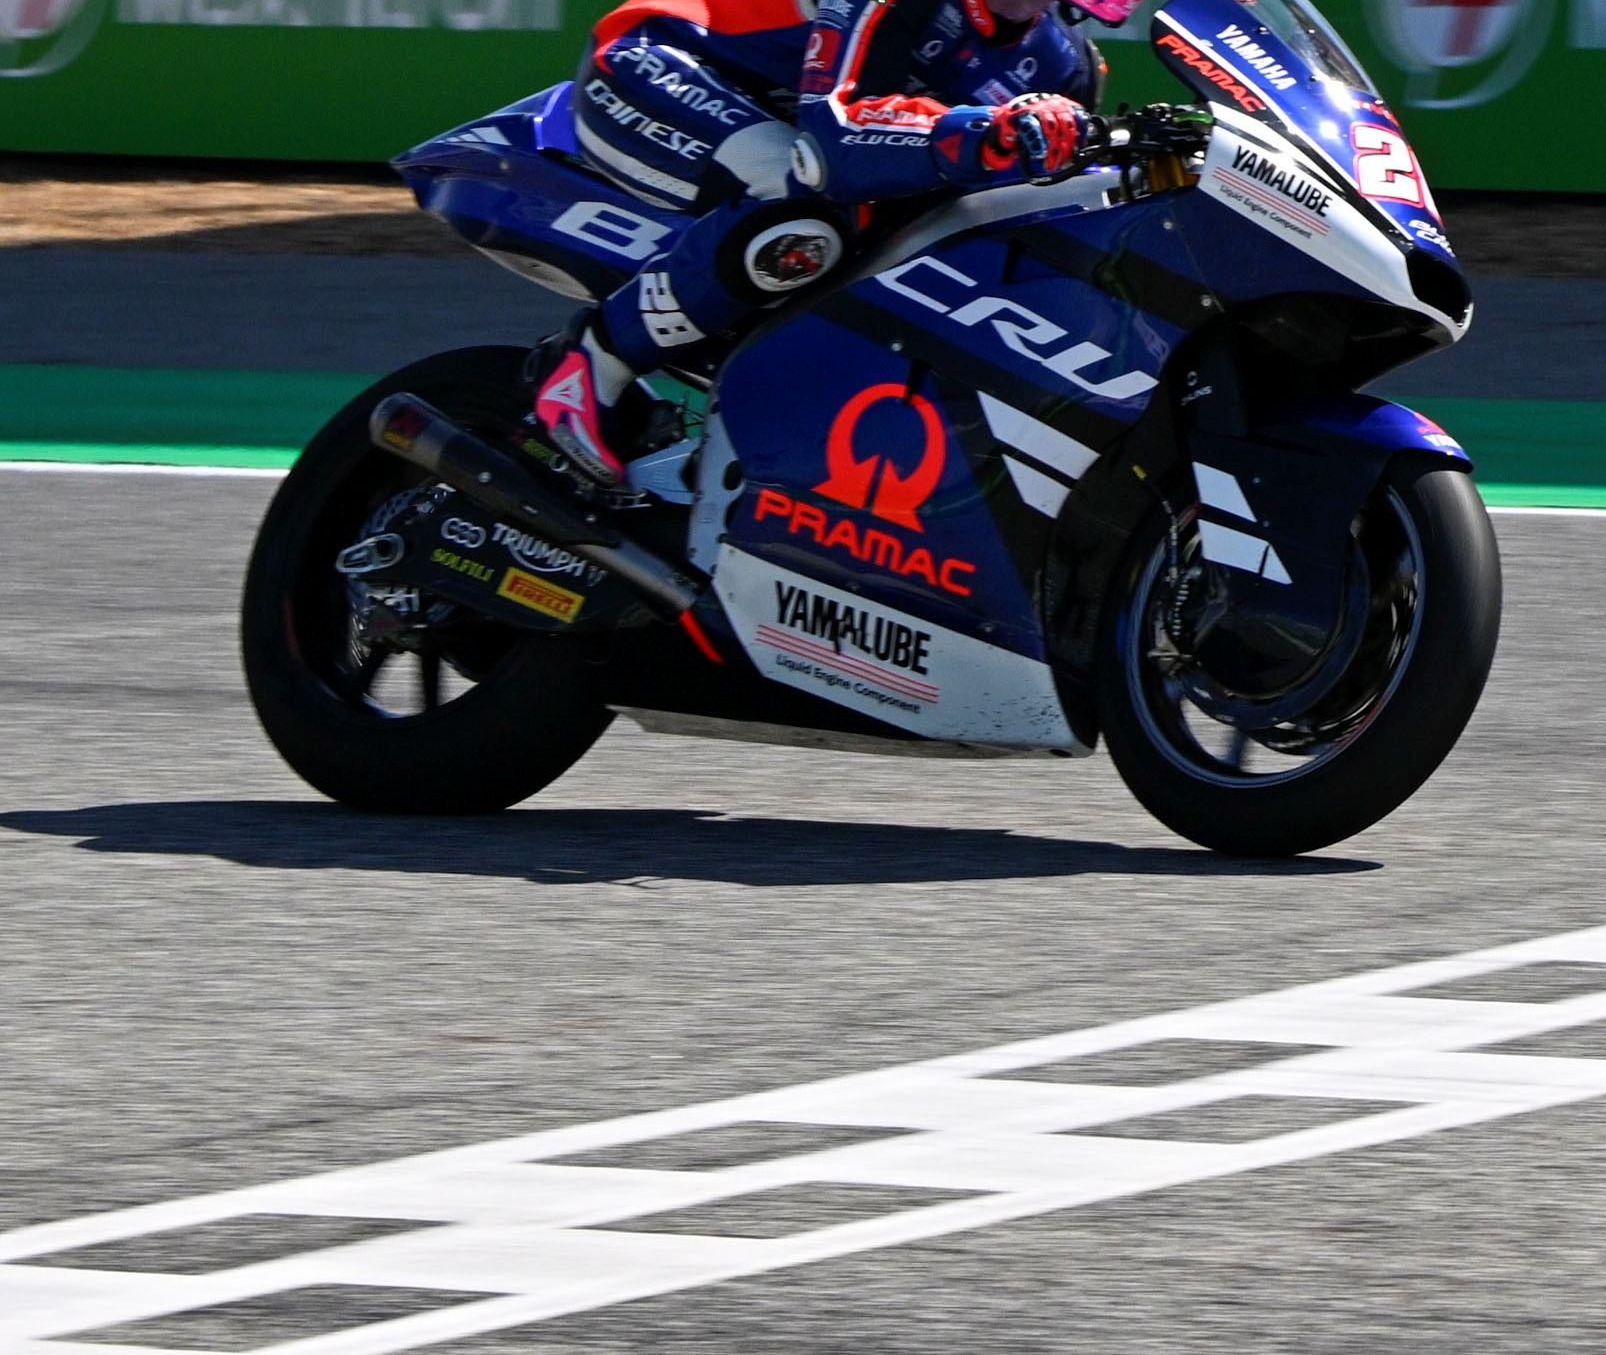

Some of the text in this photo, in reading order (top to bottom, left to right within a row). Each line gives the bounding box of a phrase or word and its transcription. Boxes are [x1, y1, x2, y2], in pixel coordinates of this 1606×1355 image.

[611, 46, 750, 126] PRAMAC
[1156, 33, 1268, 112] PRAMAC
[1215, 23, 1297, 91] YAMAHA
[584, 78, 713, 160] DAINESE
[1231, 144, 1333, 219] YAMALUBE
[874, 255, 1160, 400] CRU
[491, 522, 590, 577] TRIUMPH
[753, 488, 977, 597] PRAMAC
[507, 574, 577, 617] PIRELLI
[774, 579, 932, 676] YAMALUBE
[813, 667, 851, 690] Engine
[853, 681, 922, 715] Component
